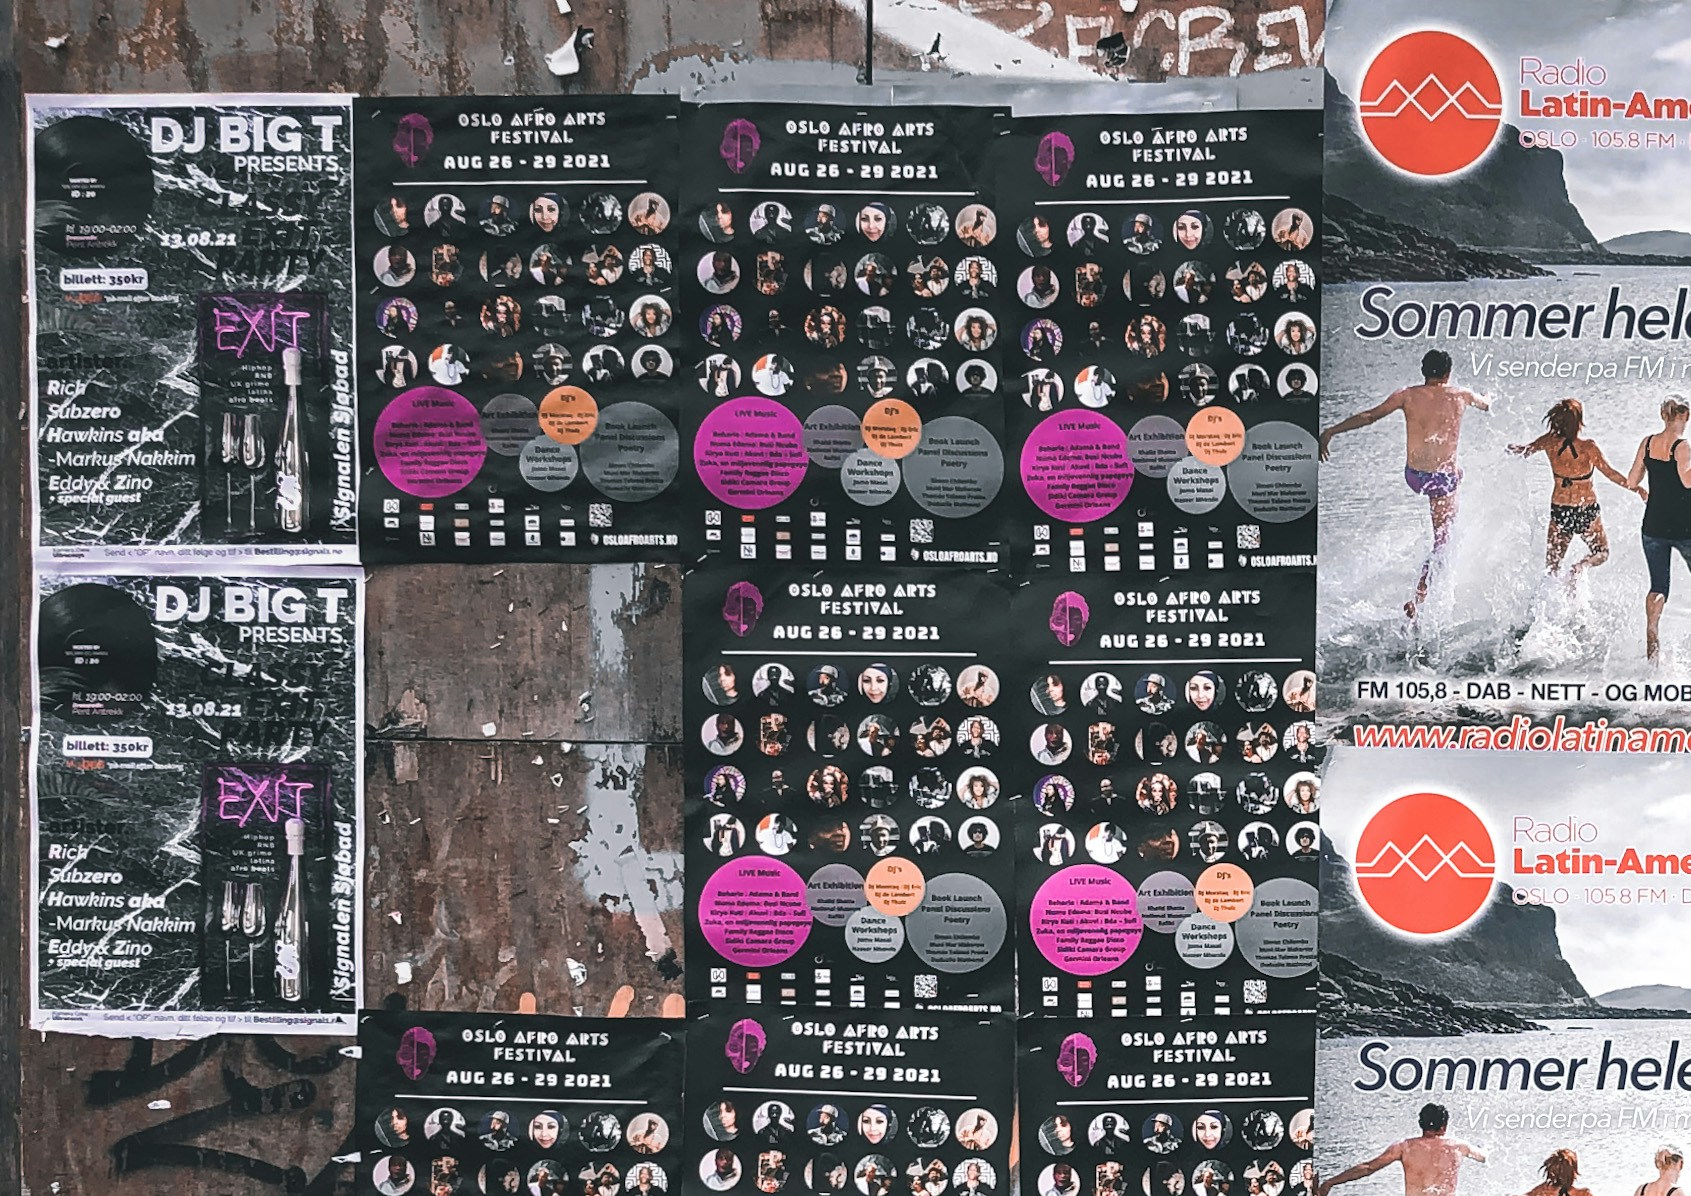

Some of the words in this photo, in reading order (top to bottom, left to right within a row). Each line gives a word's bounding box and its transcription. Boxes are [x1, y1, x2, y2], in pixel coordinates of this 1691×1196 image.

[1519, 56, 1607, 87] Radio
[458, 114, 502, 127] OSLO
[511, 112, 555, 126] AFRO
[563, 112, 606, 126] ARTS
[151, 116, 206, 153] DJ
[221, 116, 302, 152] BIG
[312, 115, 343, 152] T
[491, 131, 573, 144] FESTIVAL
[1519, 131, 1578, 149] OSLO
[1591, 131, 1641, 150] 105.8
[1645, 132, 1677, 149] FM
[444, 155, 482, 169] AUG
[489, 155, 512, 169] 26
[533, 155, 556, 168] 29
[563, 154, 610, 168] 2021
[160, 232, 237, 249] 13.08.21
[63, 273, 107, 286] billett:
[109, 273, 145, 287] 350kr
[1356, 284, 1596, 341] Sommer
[213, 304, 311, 358] EXIT
[1471, 352, 1493, 376] Vi
[1497, 354, 1583, 378] sender
[1624, 356, 1665, 378] FM
[47, 380, 86, 396] Rich
[48, 404, 122, 419] Subzero
[47, 427, 122, 443] Hawkins
[128, 427, 164, 443] aka
[126, 450, 196, 466] Nakkim
[333, 428, 356, 521] Signalen
[49, 475, 94, 496] Eddy
[113, 474, 153, 490] Zino
[106, 493, 141, 505] guest
[1357, 681, 1389, 699] FM
[1395, 682, 1446, 702] 105,8
[1466, 682, 1511, 700] DAB
[1531, 683, 1586, 701] NETT
[1605, 683, 1638, 701] OG
[1121, 1032, 1166, 1046] OSLO
[1172, 1031, 1218, 1045] AFRO
[1225, 1030, 1267, 1044] ARTS
[1153, 1049, 1236, 1063] FESTIVAL
[1107, 1074, 1146, 1089] AUG
[1152, 1074, 1176, 1088] 26
[1195, 1073, 1219, 1087] 29
[1225, 1072, 1272, 1086] 2021
